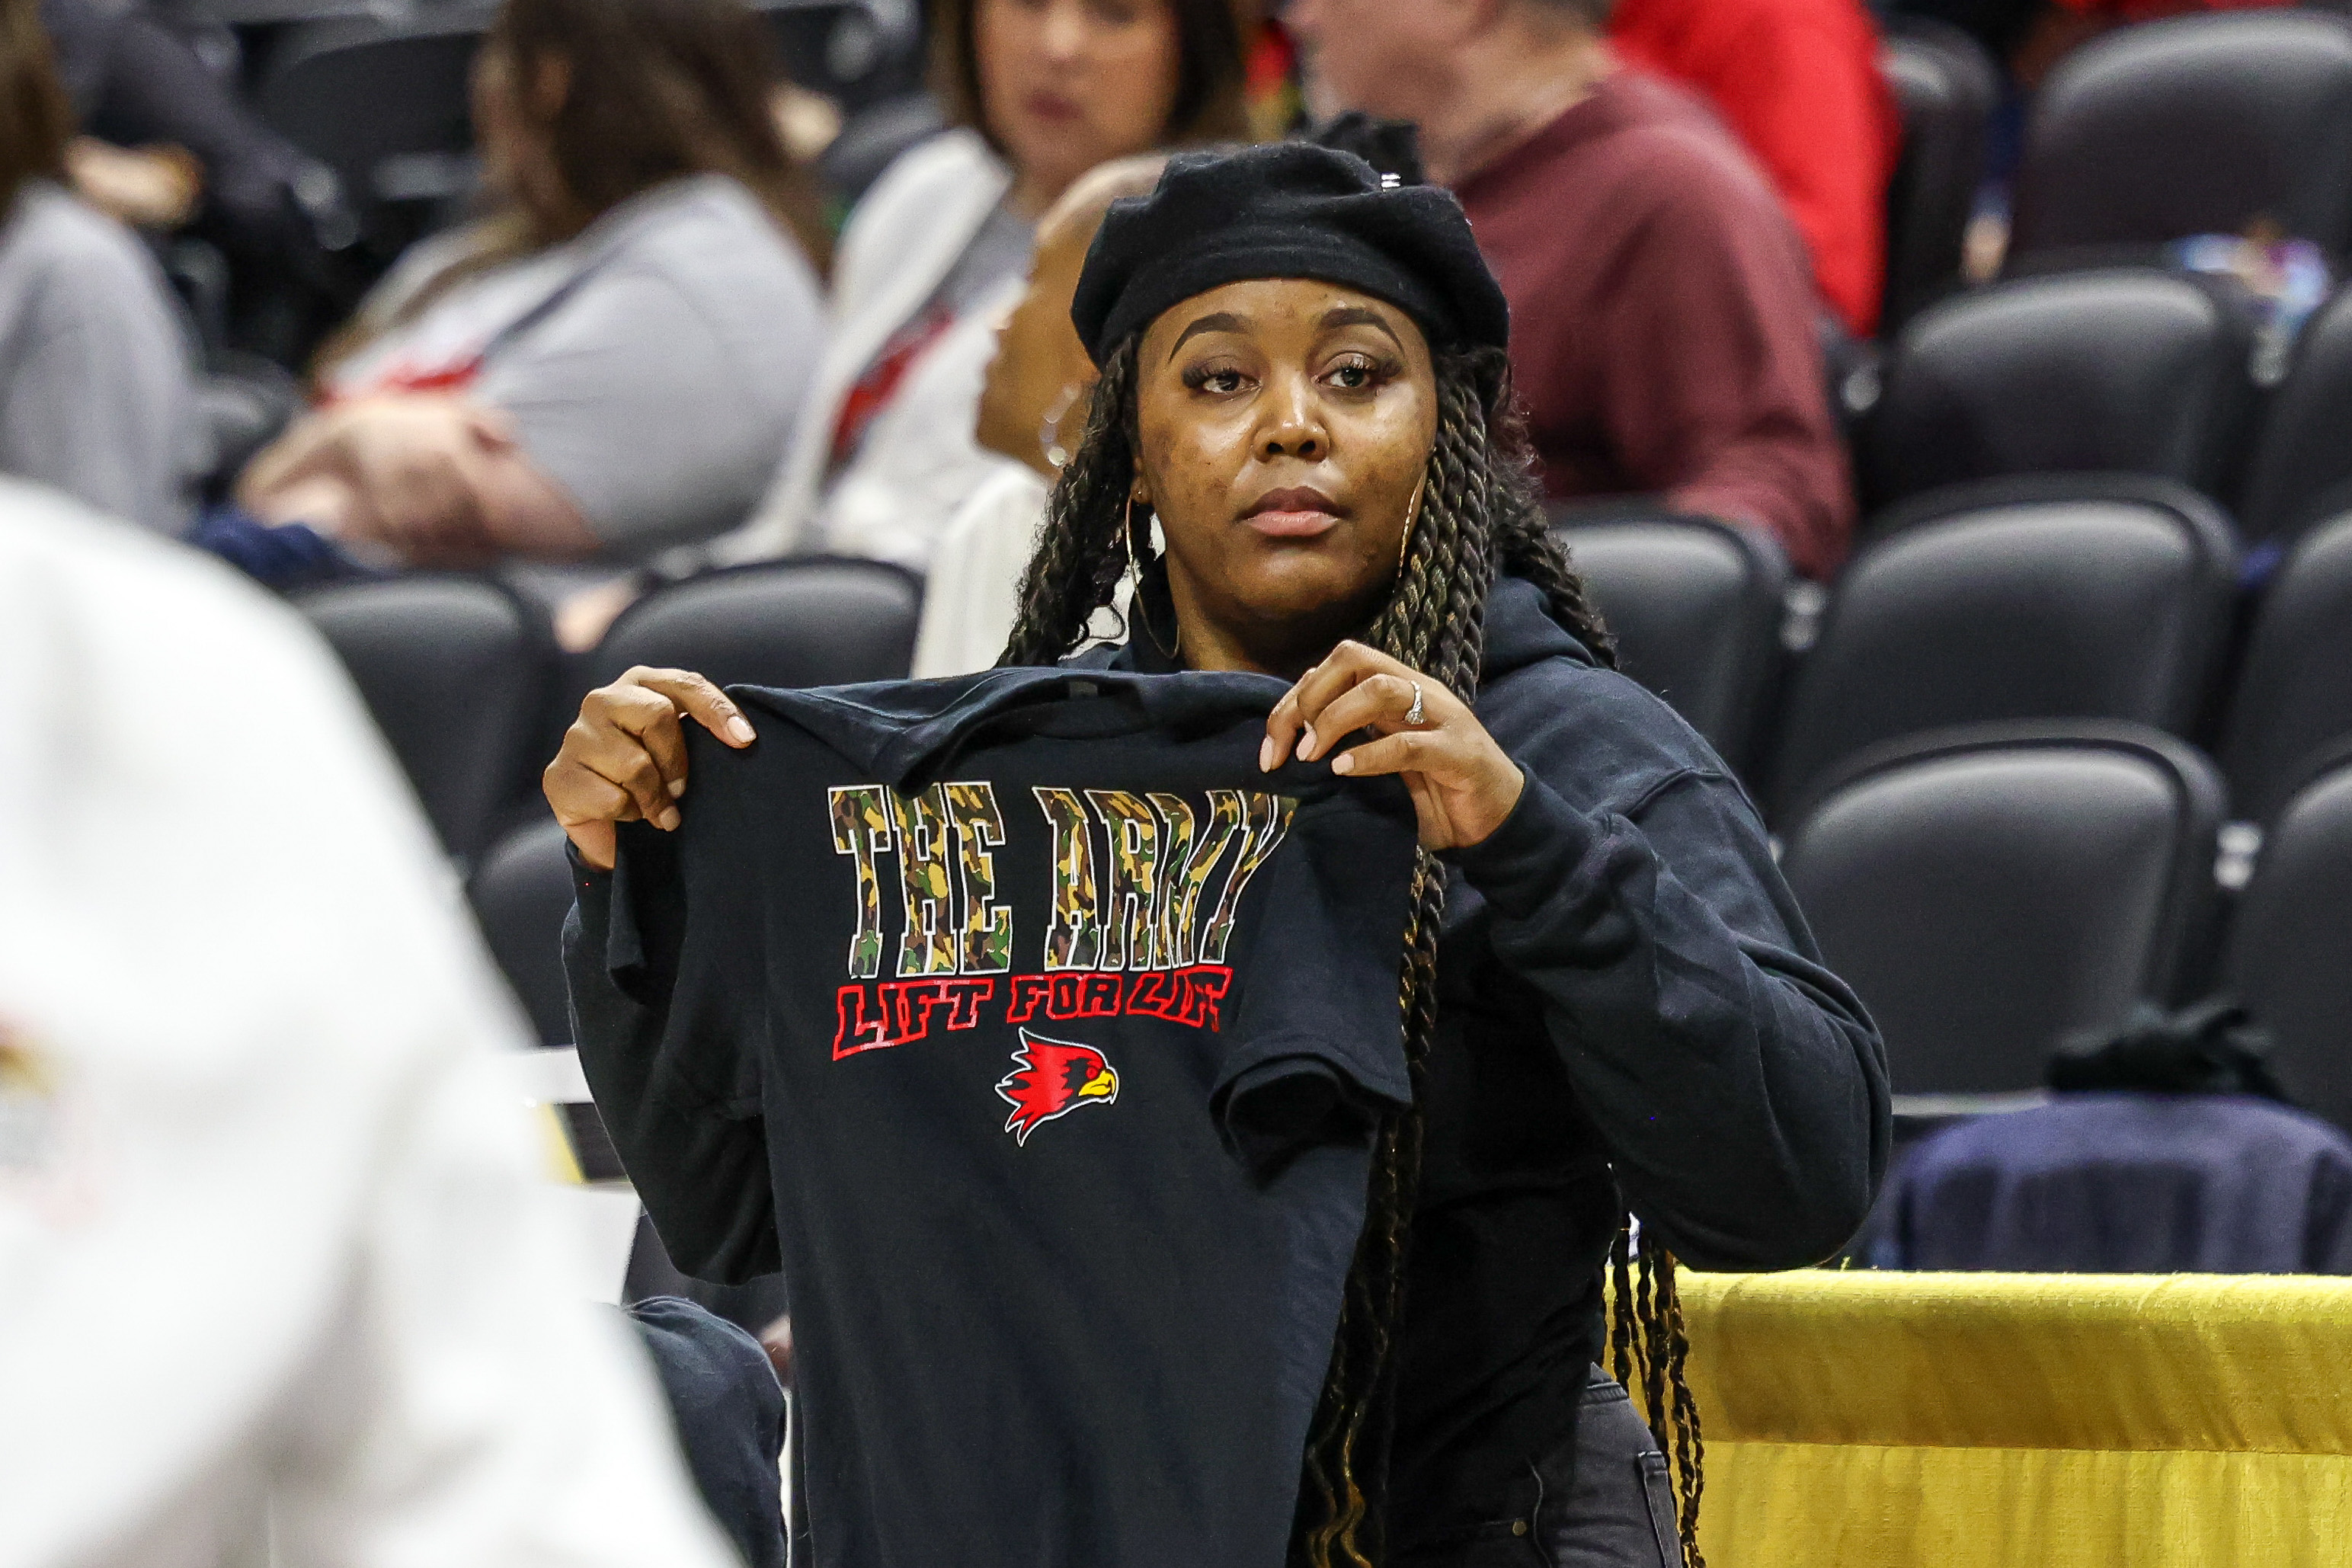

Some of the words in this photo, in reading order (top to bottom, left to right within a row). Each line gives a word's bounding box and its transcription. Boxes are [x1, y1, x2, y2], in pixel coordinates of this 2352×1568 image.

[827, 781, 1013, 978] THE
[1032, 786, 1298, 971] ARMY
[832, 978, 994, 1061] LIFT
[1006, 973, 1124, 1023] FOR
[1125, 964, 1234, 1032] LIF
